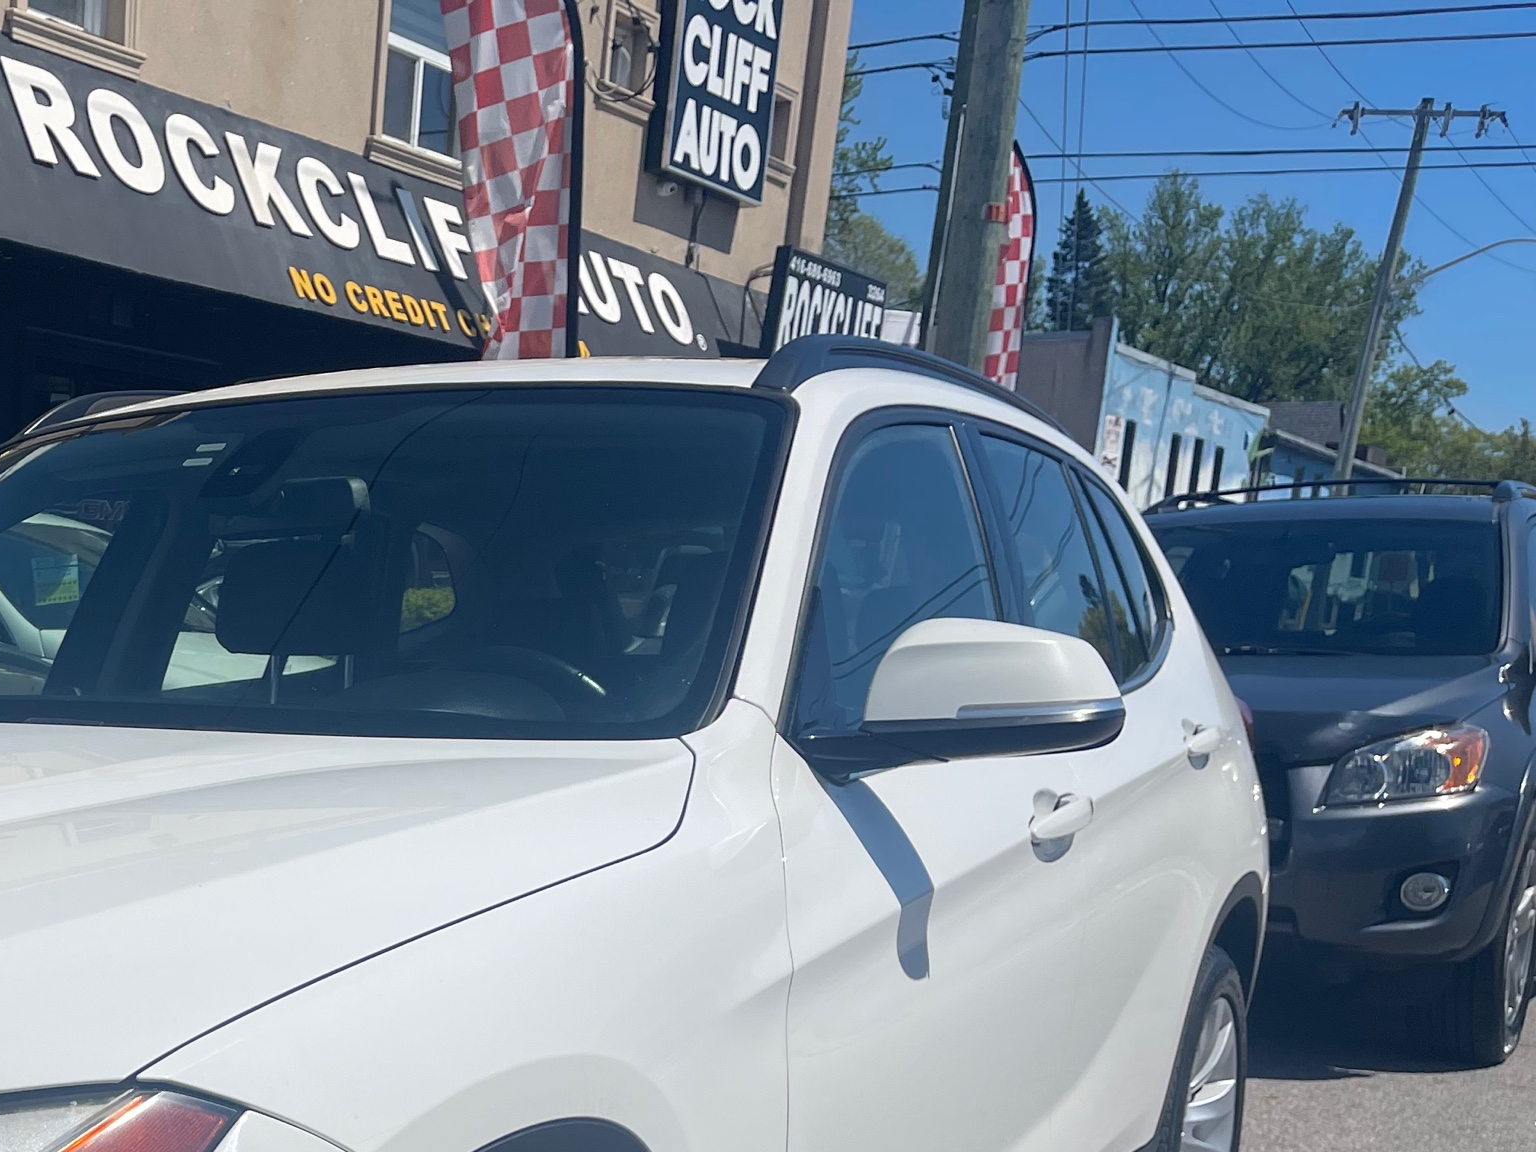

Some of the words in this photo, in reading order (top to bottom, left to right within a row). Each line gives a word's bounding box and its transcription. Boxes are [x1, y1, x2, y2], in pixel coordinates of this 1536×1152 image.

[683, 13, 773, 114] CLIFF
[672, 97, 762, 192] AUTO
[0, 55, 472, 281] ROCKCLIF
[578, 250, 694, 345] UTO
[288, 266, 337, 306] NO
[344, 280, 451, 333] CREDIT
